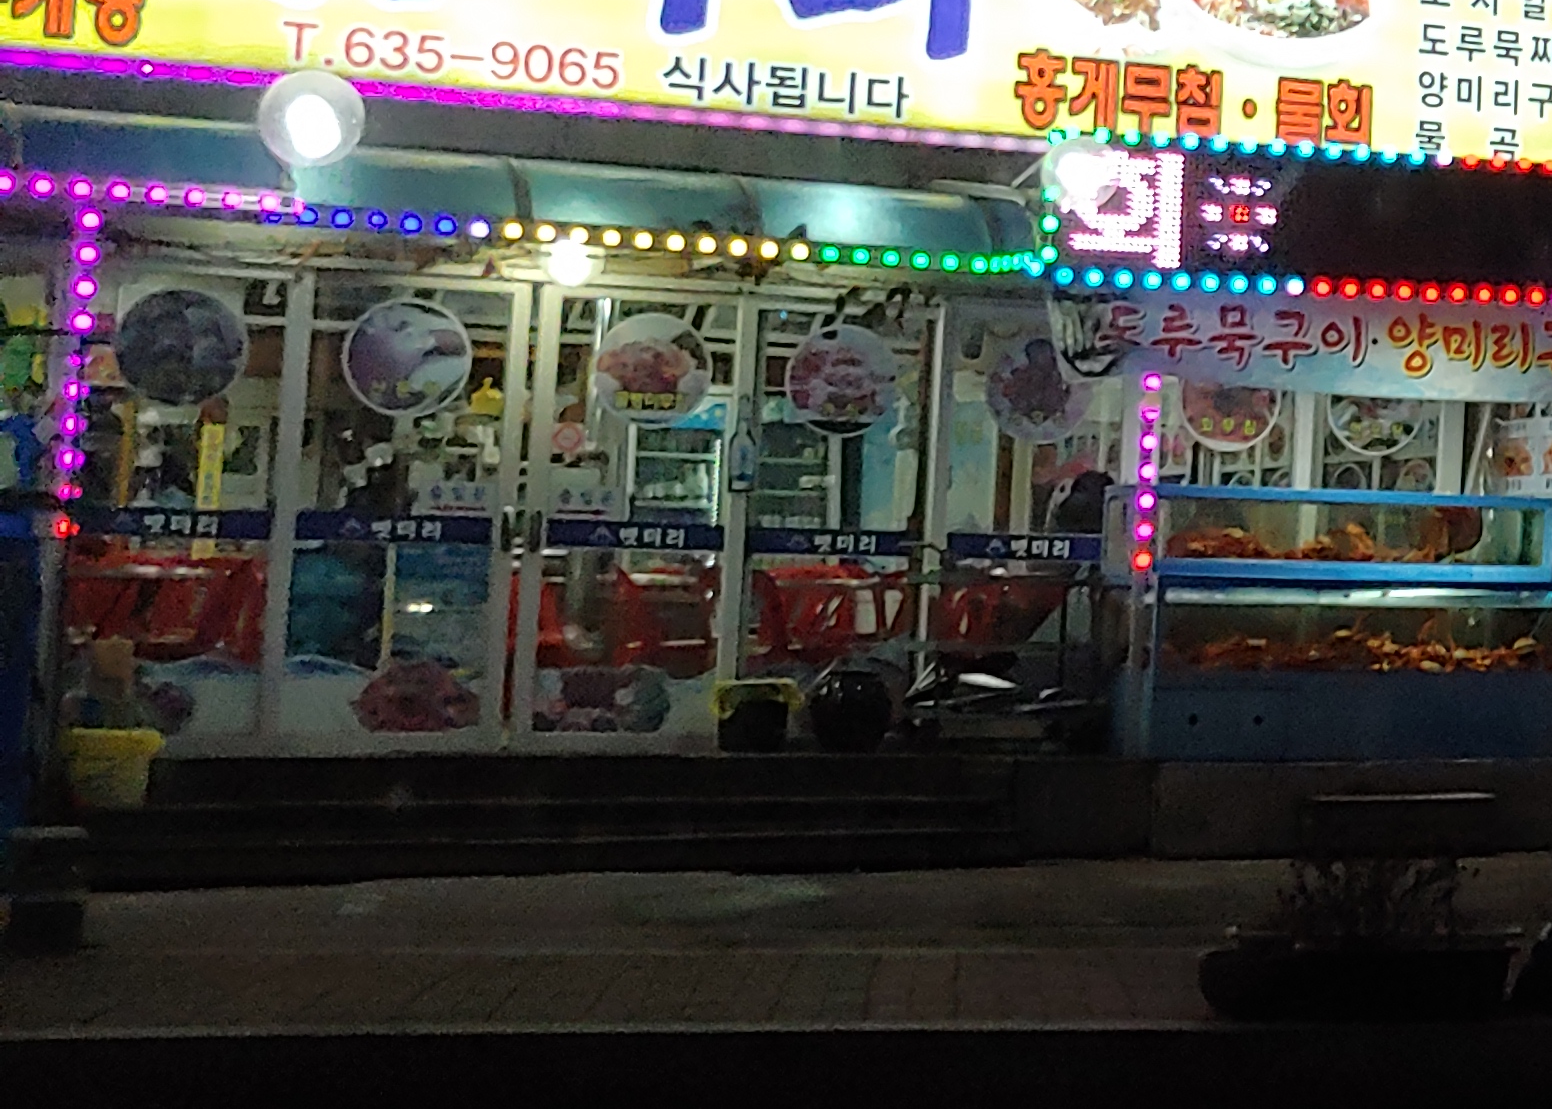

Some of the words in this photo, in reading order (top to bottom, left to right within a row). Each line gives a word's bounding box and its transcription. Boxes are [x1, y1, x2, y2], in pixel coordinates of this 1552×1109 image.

[663, 55, 910, 119] 식사됩니다
[1015, 49, 1223, 137] 홍게무침
[1276, 77, 1373, 143] 물회
